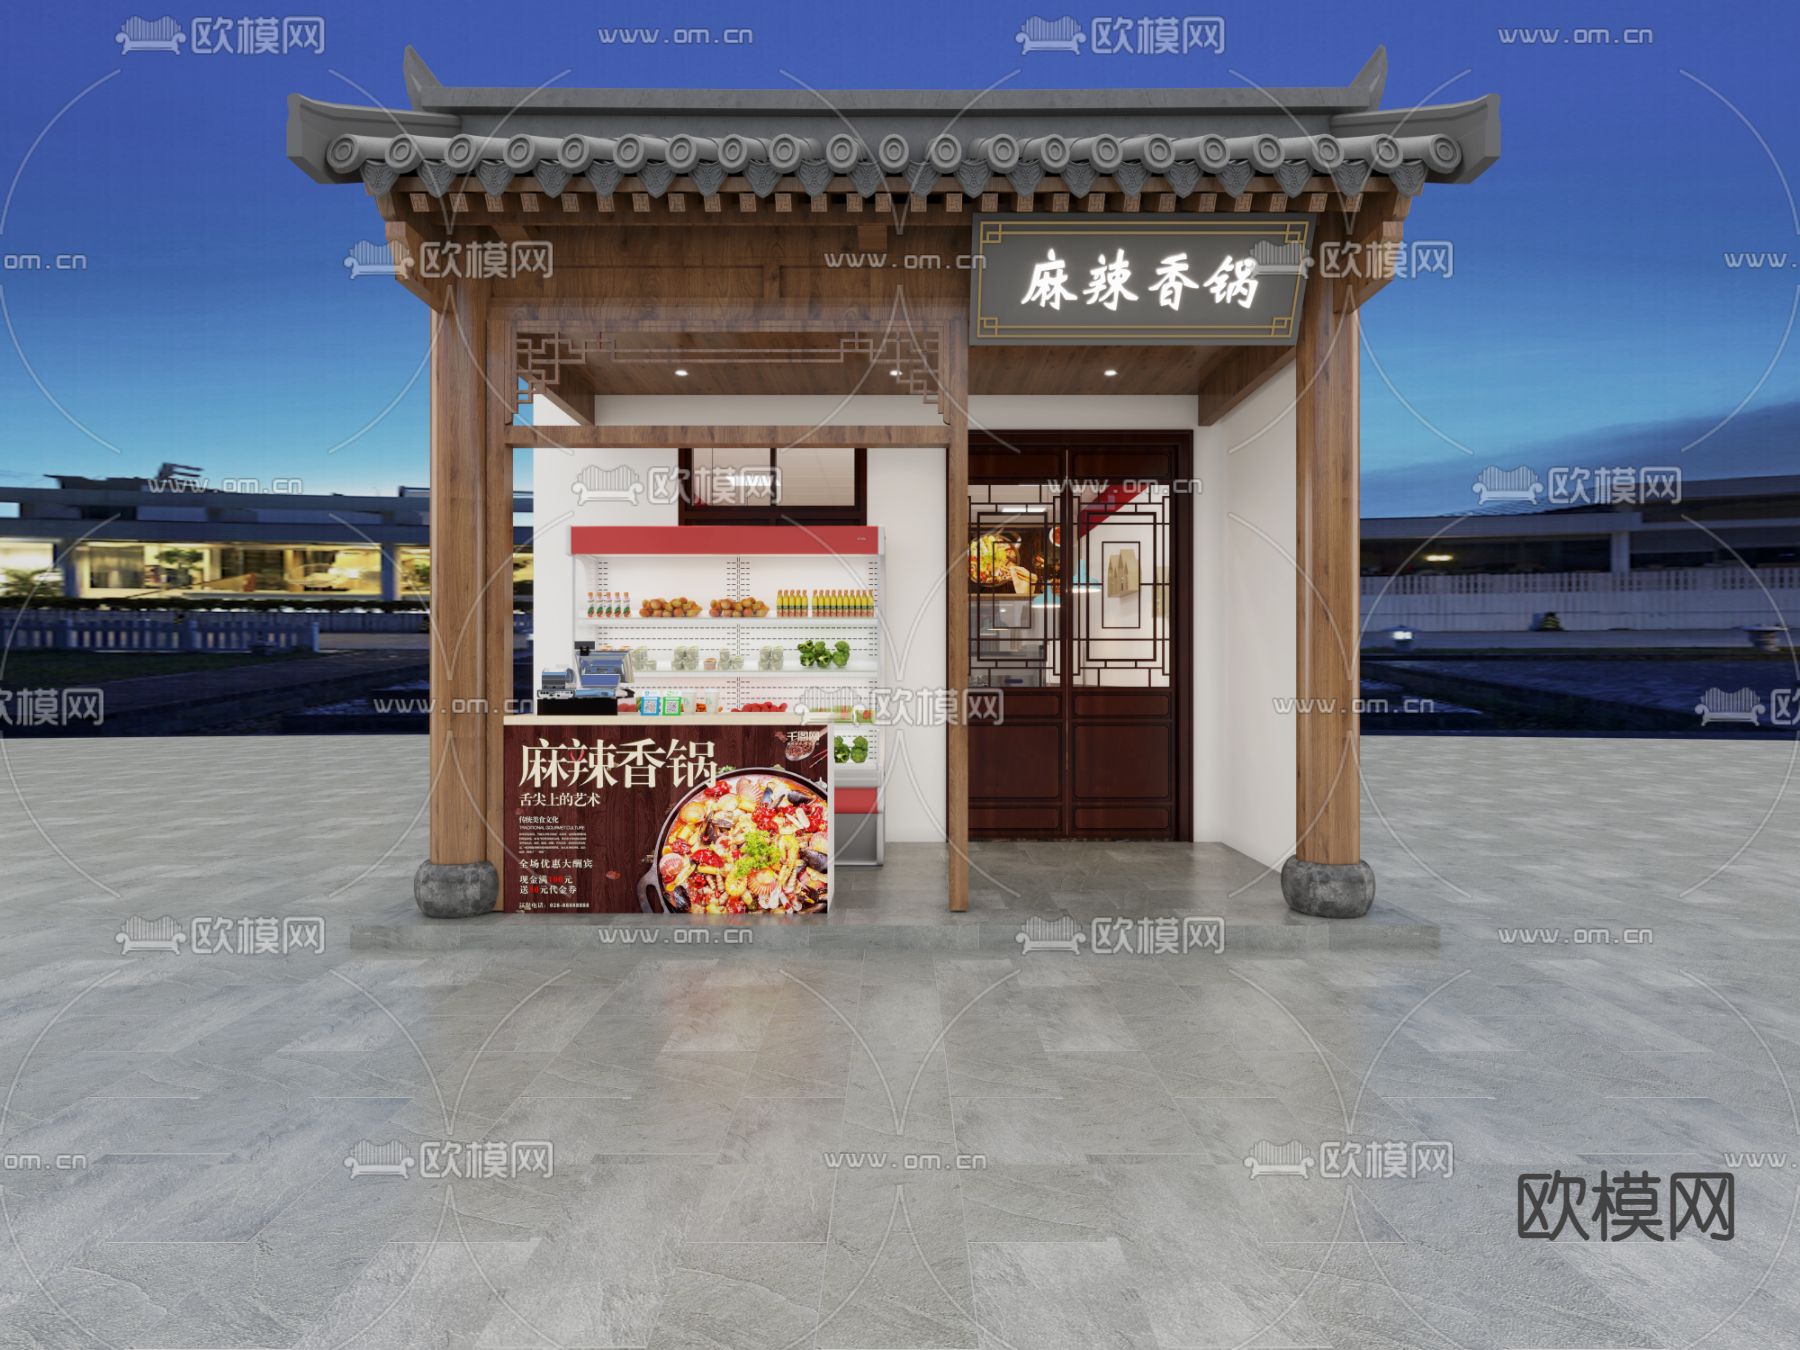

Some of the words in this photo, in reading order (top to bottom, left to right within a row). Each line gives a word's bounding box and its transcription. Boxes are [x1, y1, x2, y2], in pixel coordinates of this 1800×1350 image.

[1021, 248, 1260, 312] 麻辣香锅
[519, 737, 718, 788] 麻辣香锅
[519, 792, 601, 807] 舌尖上的艺术
[518, 816, 559, 824] 传统美食文化
[518, 858, 593, 869] 全场优惠大酬宾
